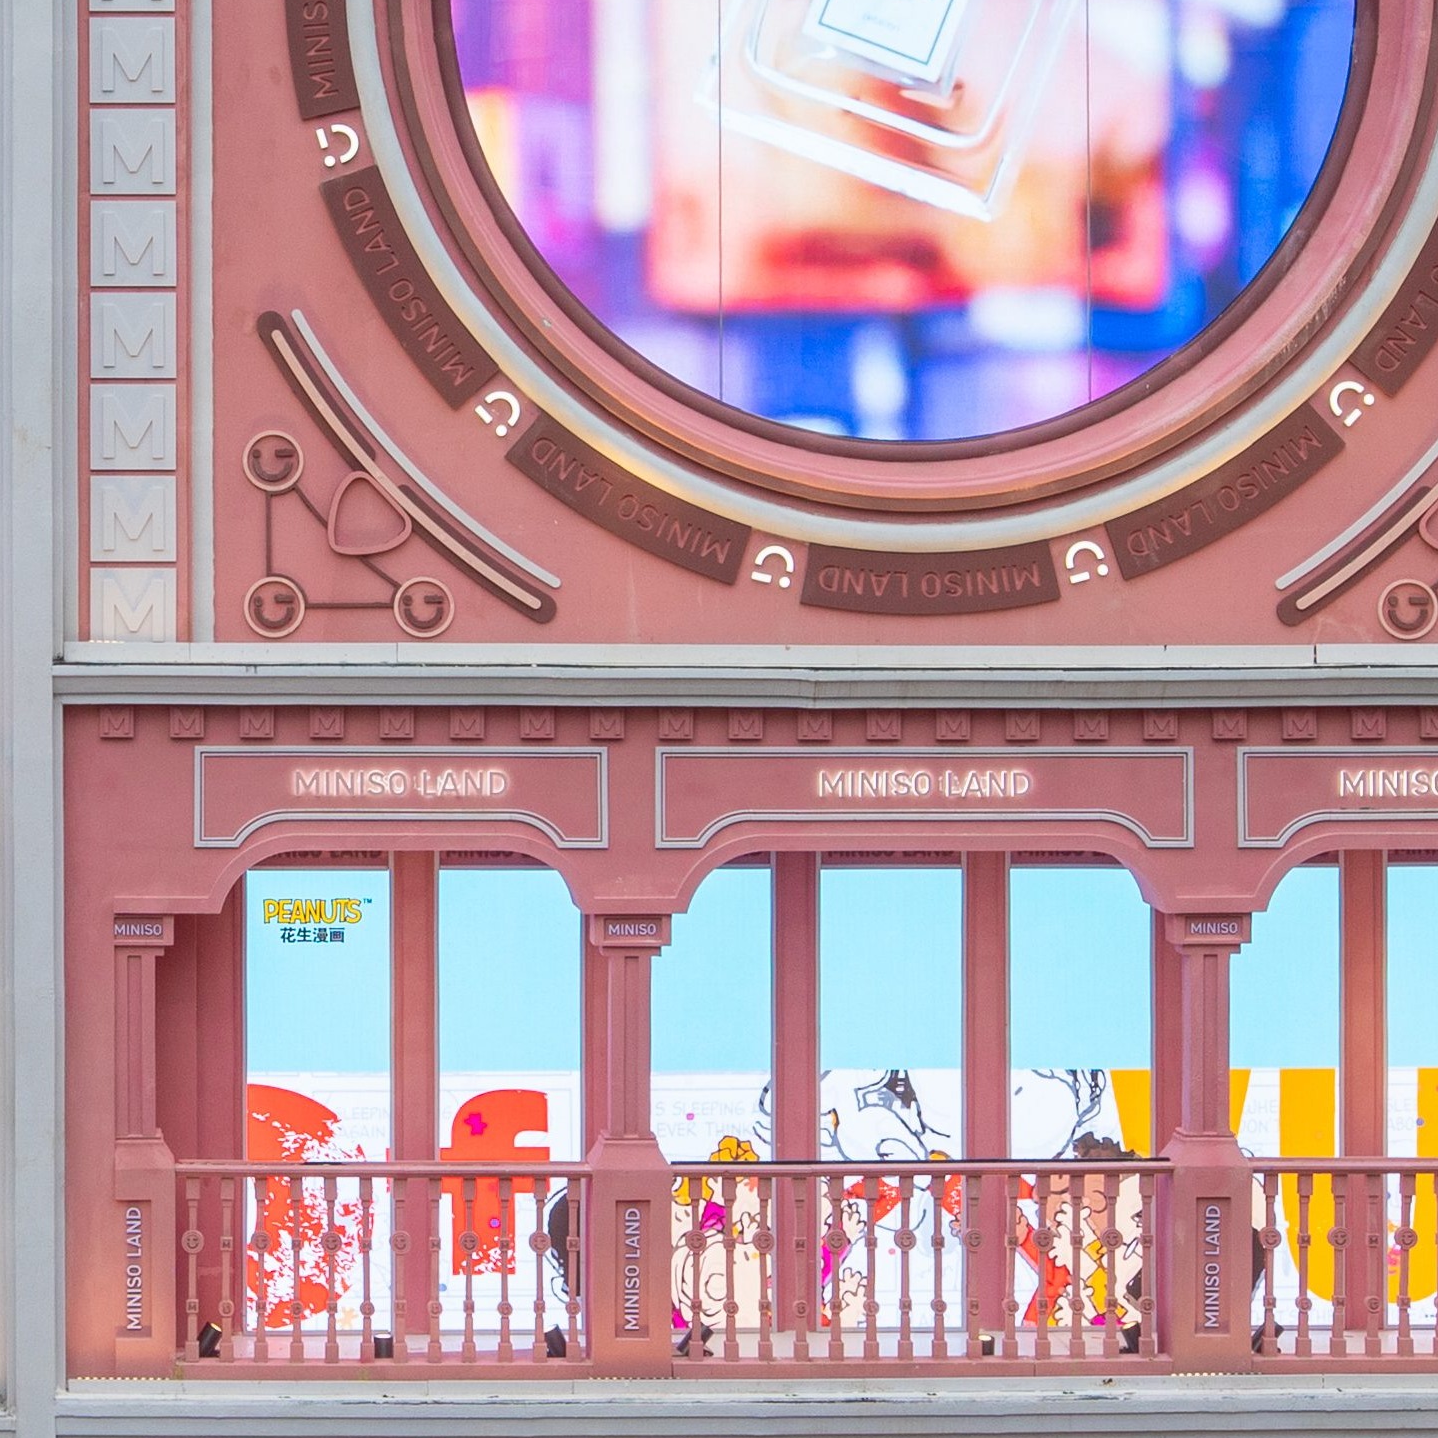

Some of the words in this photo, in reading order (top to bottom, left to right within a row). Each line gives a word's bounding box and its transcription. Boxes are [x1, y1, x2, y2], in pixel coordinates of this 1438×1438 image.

[292, 769, 406, 798] MINISO
[416, 769, 510, 798] LAND
[818, 769, 932, 798] MINISO
[941, 769, 1033, 798] LAND
[114, 922, 162, 938] MINISO
[280, 926, 345, 945] 花生漫画
[608, 921, 657, 937] MINISO
[1190, 920, 1238, 936] MINISO
[126, 1205, 141, 1260] LAND
[126, 1265, 141, 1331] MINISO
